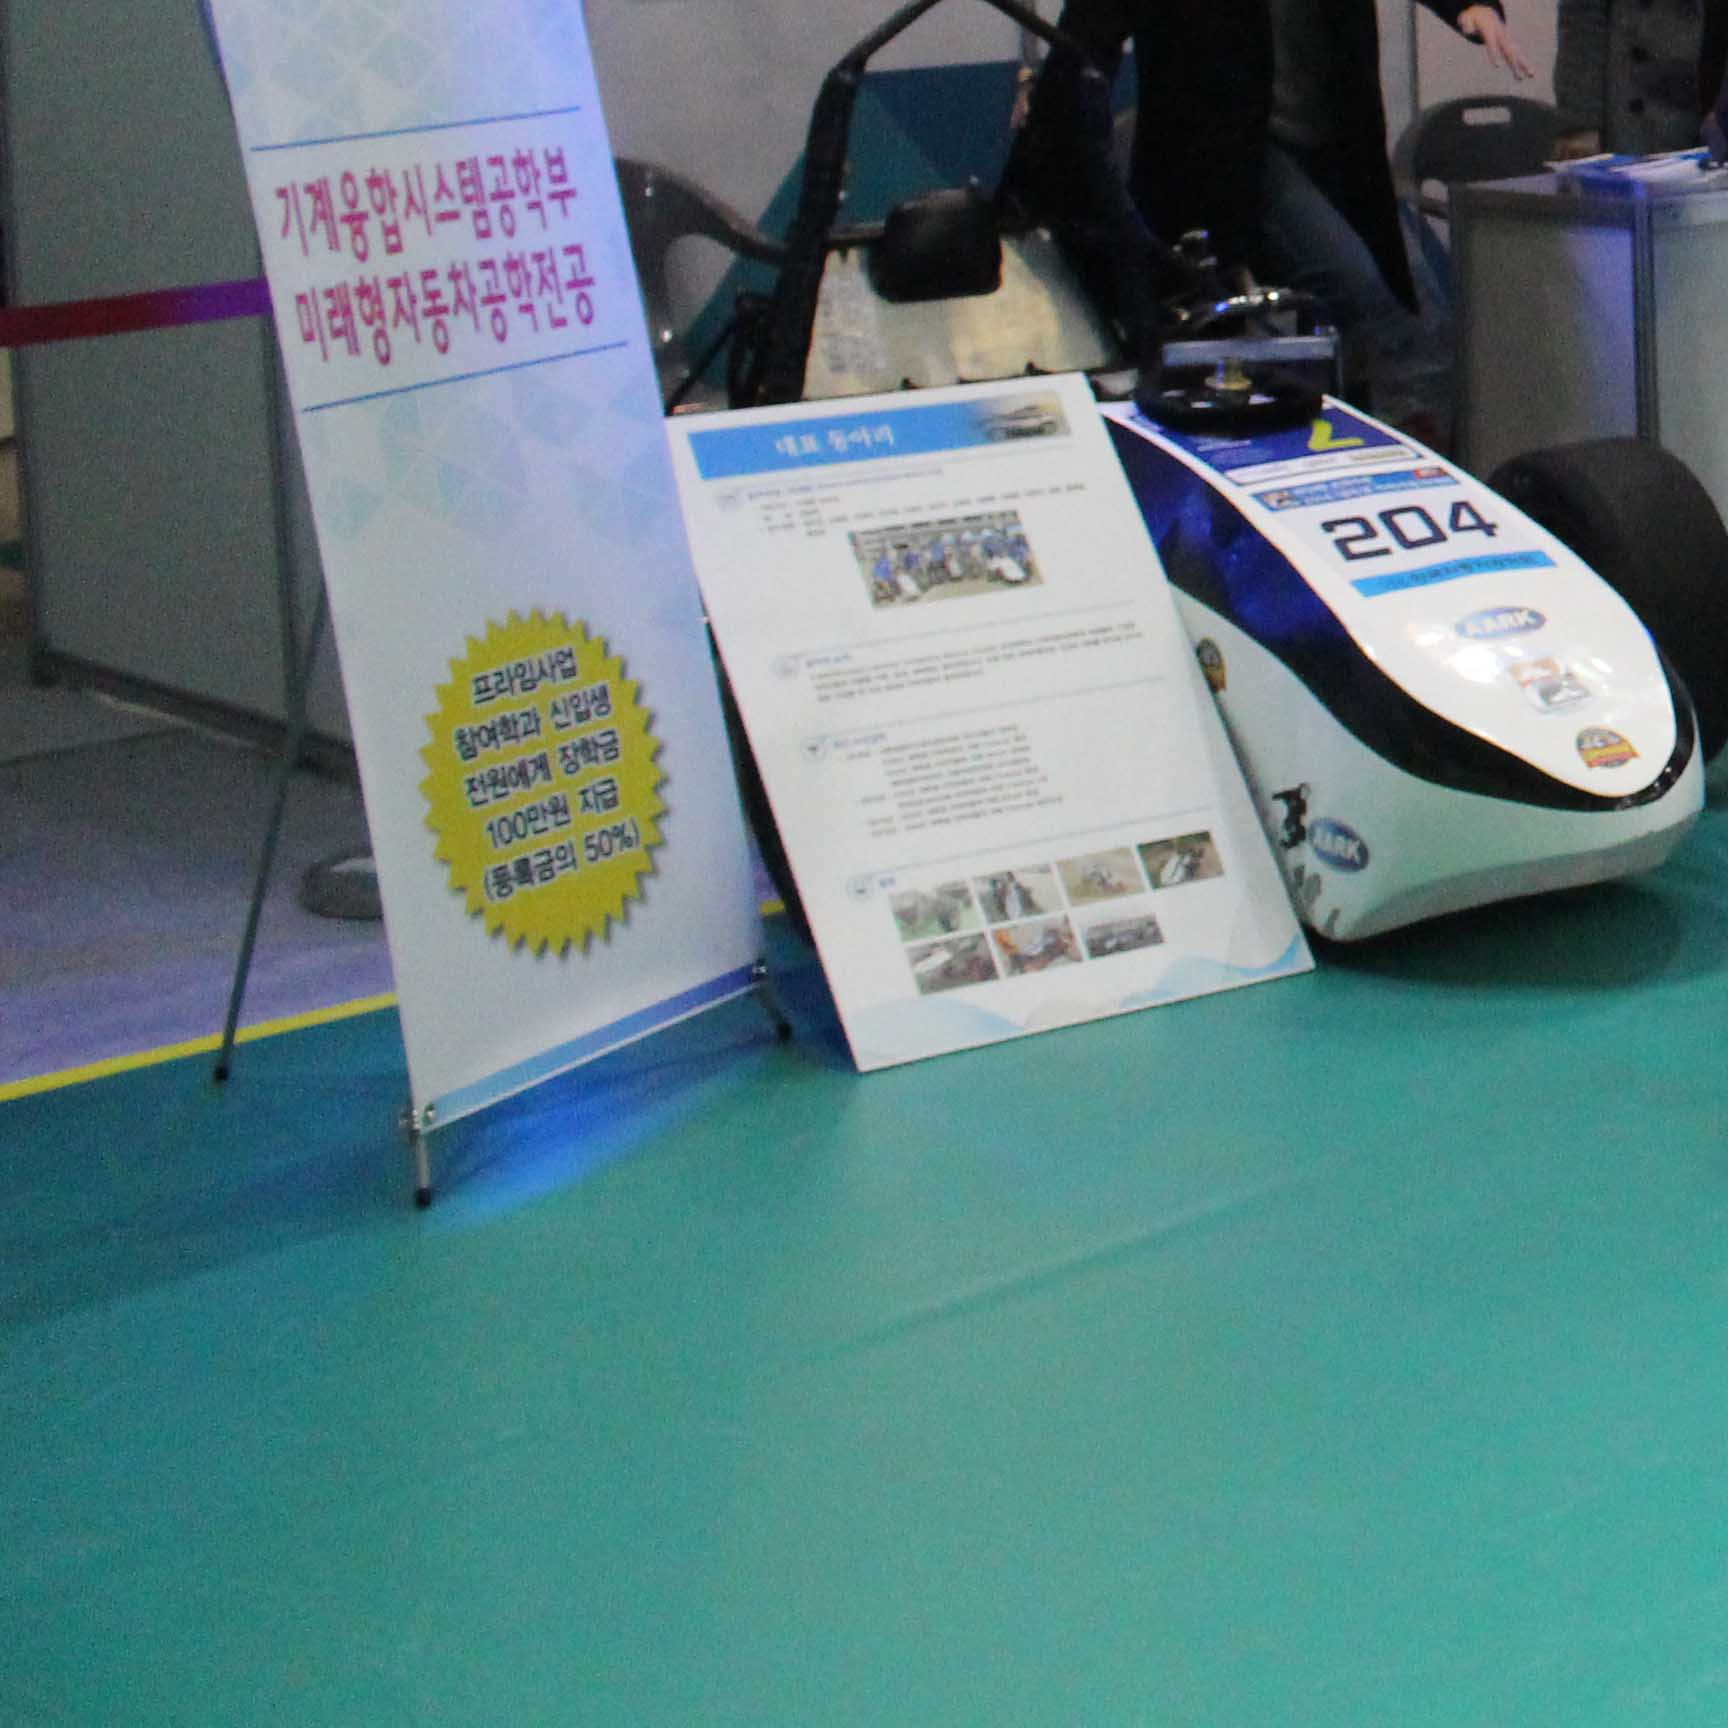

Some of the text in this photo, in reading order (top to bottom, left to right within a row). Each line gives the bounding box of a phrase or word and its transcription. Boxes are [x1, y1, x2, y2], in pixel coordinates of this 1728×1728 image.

[275, 145, 577, 263] 기계융합시스템공학부
[296, 244, 595, 365] 미래형자동차공학전공
[1320, 500, 1499, 562] 204
[471, 646, 578, 705] 프라임사업
[453, 684, 612, 763] 참여학과 신입생
[464, 728, 621, 809] 전원에게 장학금
[486, 777, 620, 849] 100만원 지급
[482, 818, 640, 902] (등록금의 50%)
